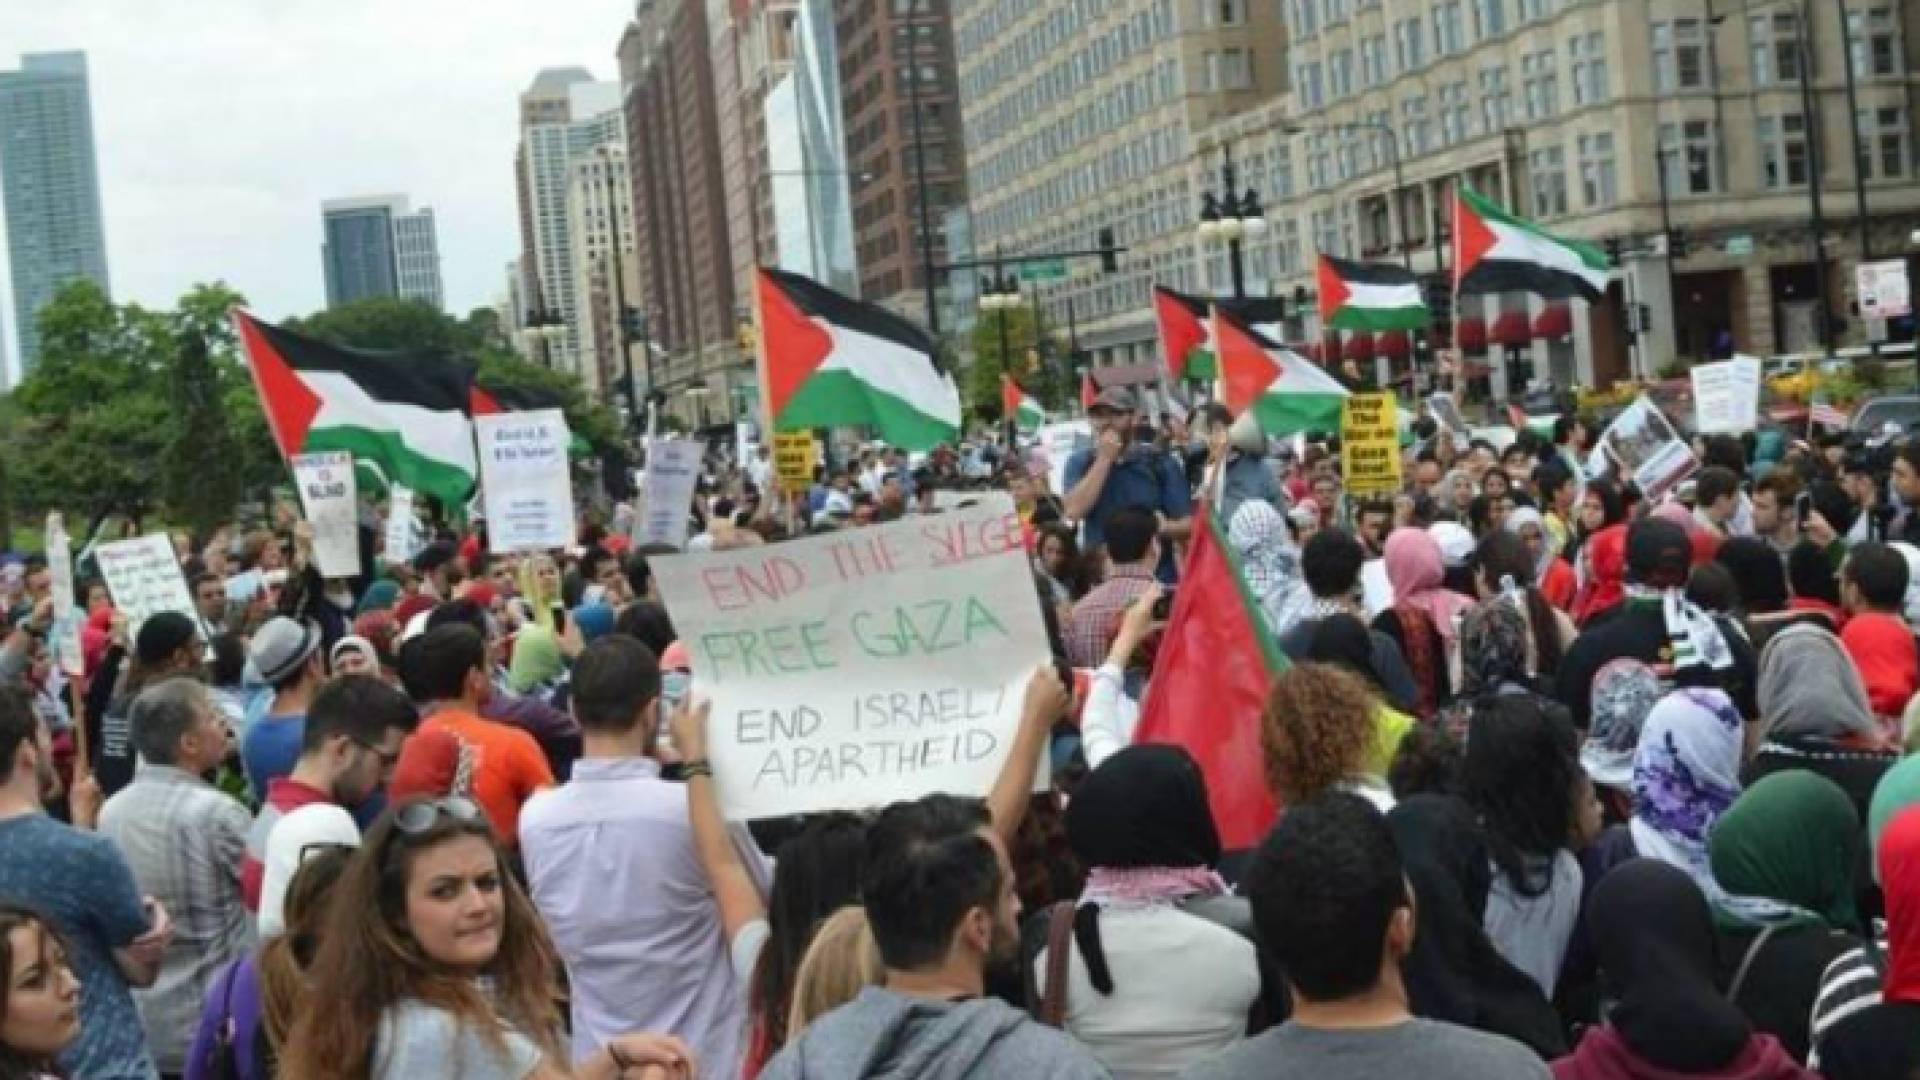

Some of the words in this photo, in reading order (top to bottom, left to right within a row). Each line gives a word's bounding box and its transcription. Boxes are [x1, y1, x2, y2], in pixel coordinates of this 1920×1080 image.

[702, 556, 806, 612] END
[826, 532, 897, 581] THE
[921, 513, 1027, 568] SIEGE
[701, 619, 839, 684] FREE
[850, 595, 1009, 659] GAZA
[736, 704, 823, 744] END
[752, 727, 998, 791] APARTHEID
